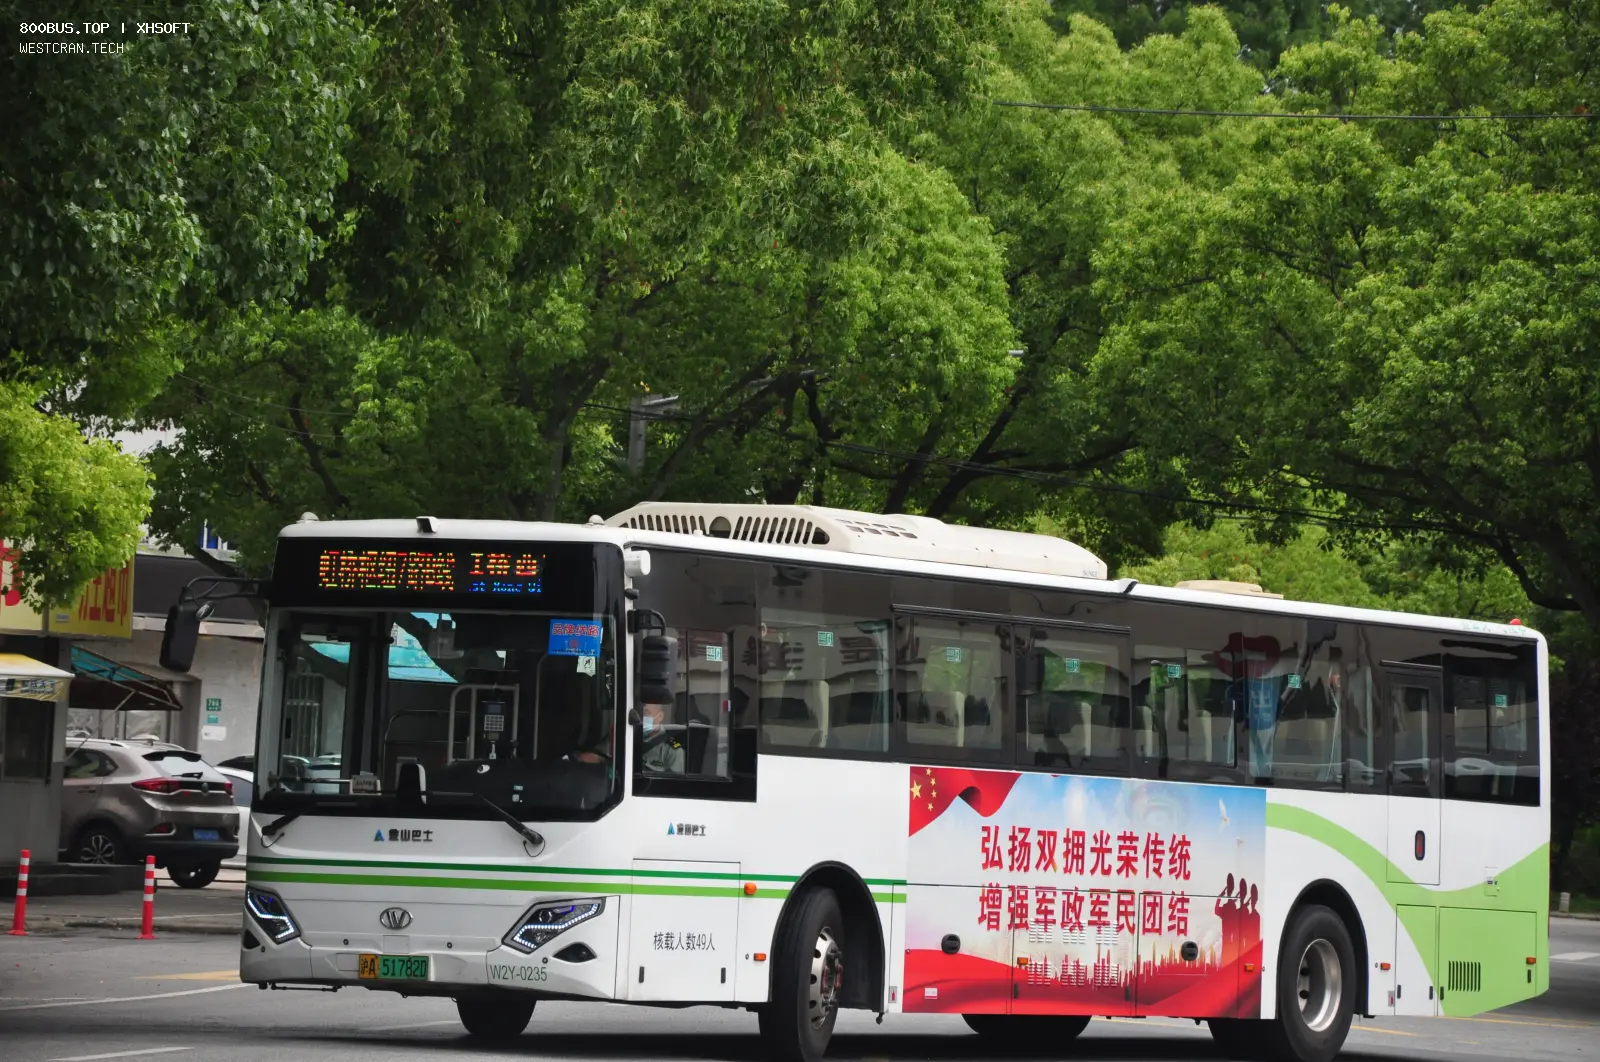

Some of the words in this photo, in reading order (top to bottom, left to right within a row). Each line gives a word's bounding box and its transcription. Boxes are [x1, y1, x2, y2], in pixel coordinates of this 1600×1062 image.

[552, 623, 600, 637] 品牌线路
[980, 824, 1192, 881] 弘扬双拥光荣传统
[977, 882, 1191, 937] 增强军政军民团结
[653, 931, 716, 951] 核载人数49人
[489, 965, 548, 982] W2Y-0235
